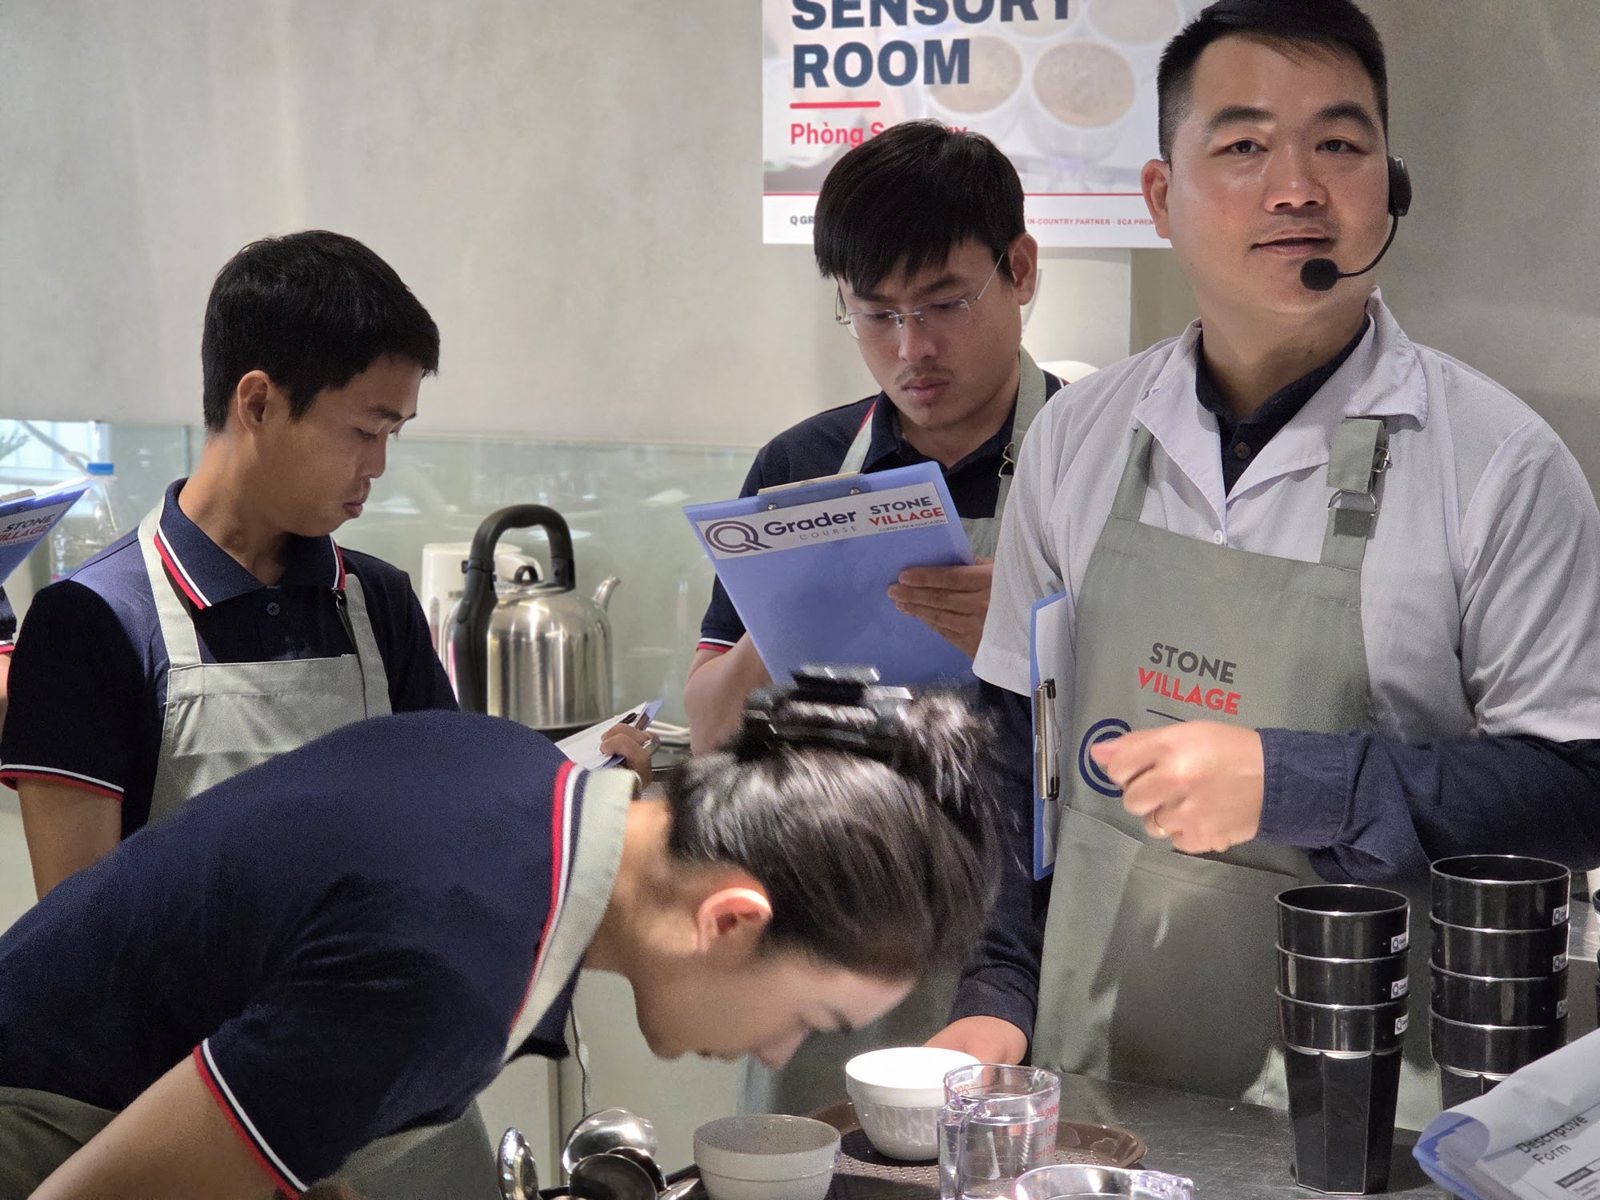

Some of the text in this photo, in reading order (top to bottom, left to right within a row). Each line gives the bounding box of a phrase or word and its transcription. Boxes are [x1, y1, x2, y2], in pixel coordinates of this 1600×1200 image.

[793, 39, 970, 88] ROOM
[790, 122, 864, 147] Phòng
[790, 215, 798, 226] Q
[868, 507, 945, 526] VILLAGE
[870, 496, 932, 515] STONE
[764, 511, 857, 536] Grader
[800, 525, 857, 541] COURSE
[1150, 642, 1237, 684] STONE
[1137, 667, 1241, 715] VILLAGE
[1516, 1116, 1588, 1153] Descriptive
[1532, 1144, 1572, 1165] Form
